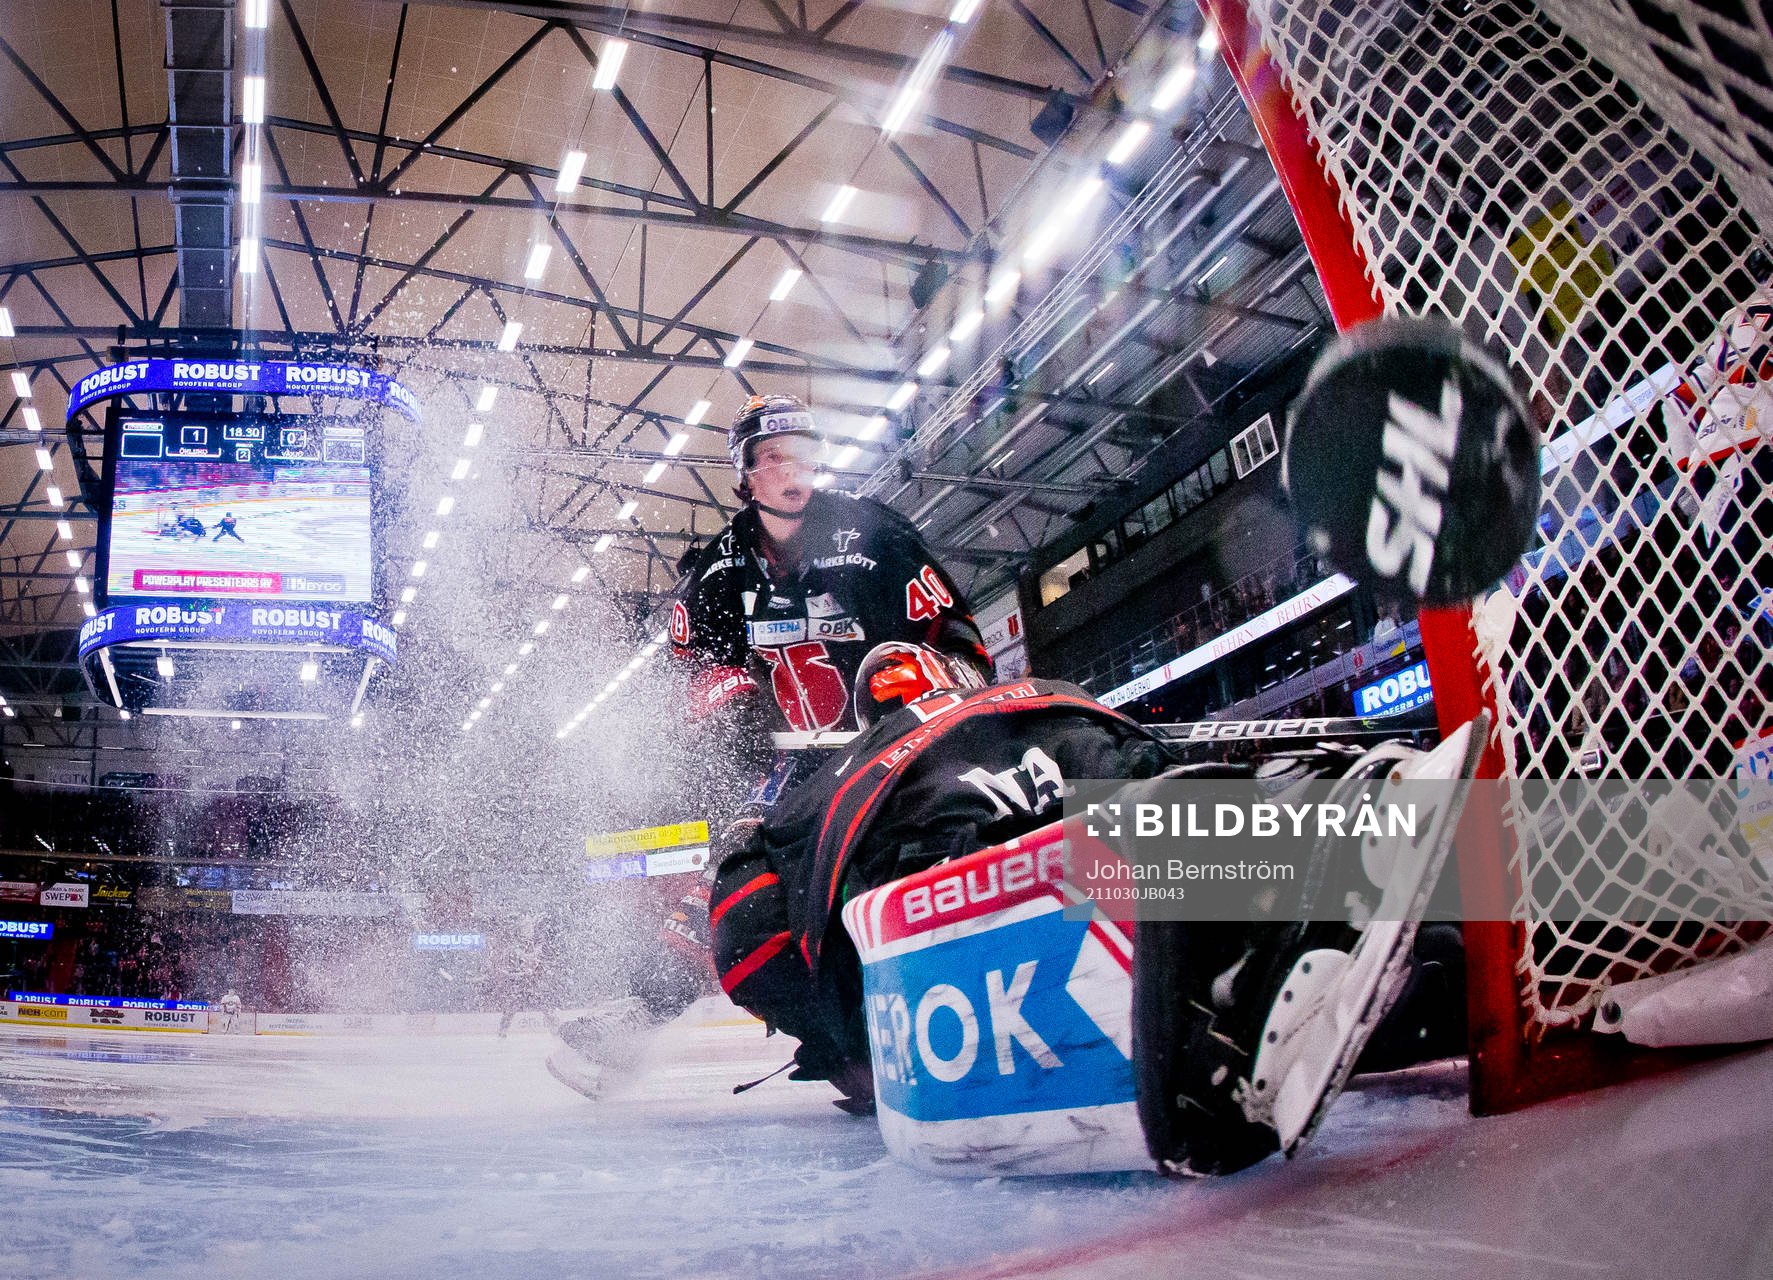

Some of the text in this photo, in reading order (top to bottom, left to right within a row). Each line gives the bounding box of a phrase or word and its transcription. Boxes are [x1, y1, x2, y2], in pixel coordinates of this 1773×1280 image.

[81, 363, 149, 396] ROBUST
[173, 363, 261, 381] ROBUST
[285, 366, 371, 388] ROBUST
[192, 429, 200, 442] 1
[228, 427, 260, 438] 18.30
[1366, 380, 1463, 597] SHL
[846, 552, 877, 571] KÖTT
[906, 564, 954, 622] 40
[135, 606, 224, 626] ROBUST
[252, 609, 342, 630] ROBUST
[418, 934, 481, 945] ROBUST
[144, 1011, 196, 1023] ROBUST
